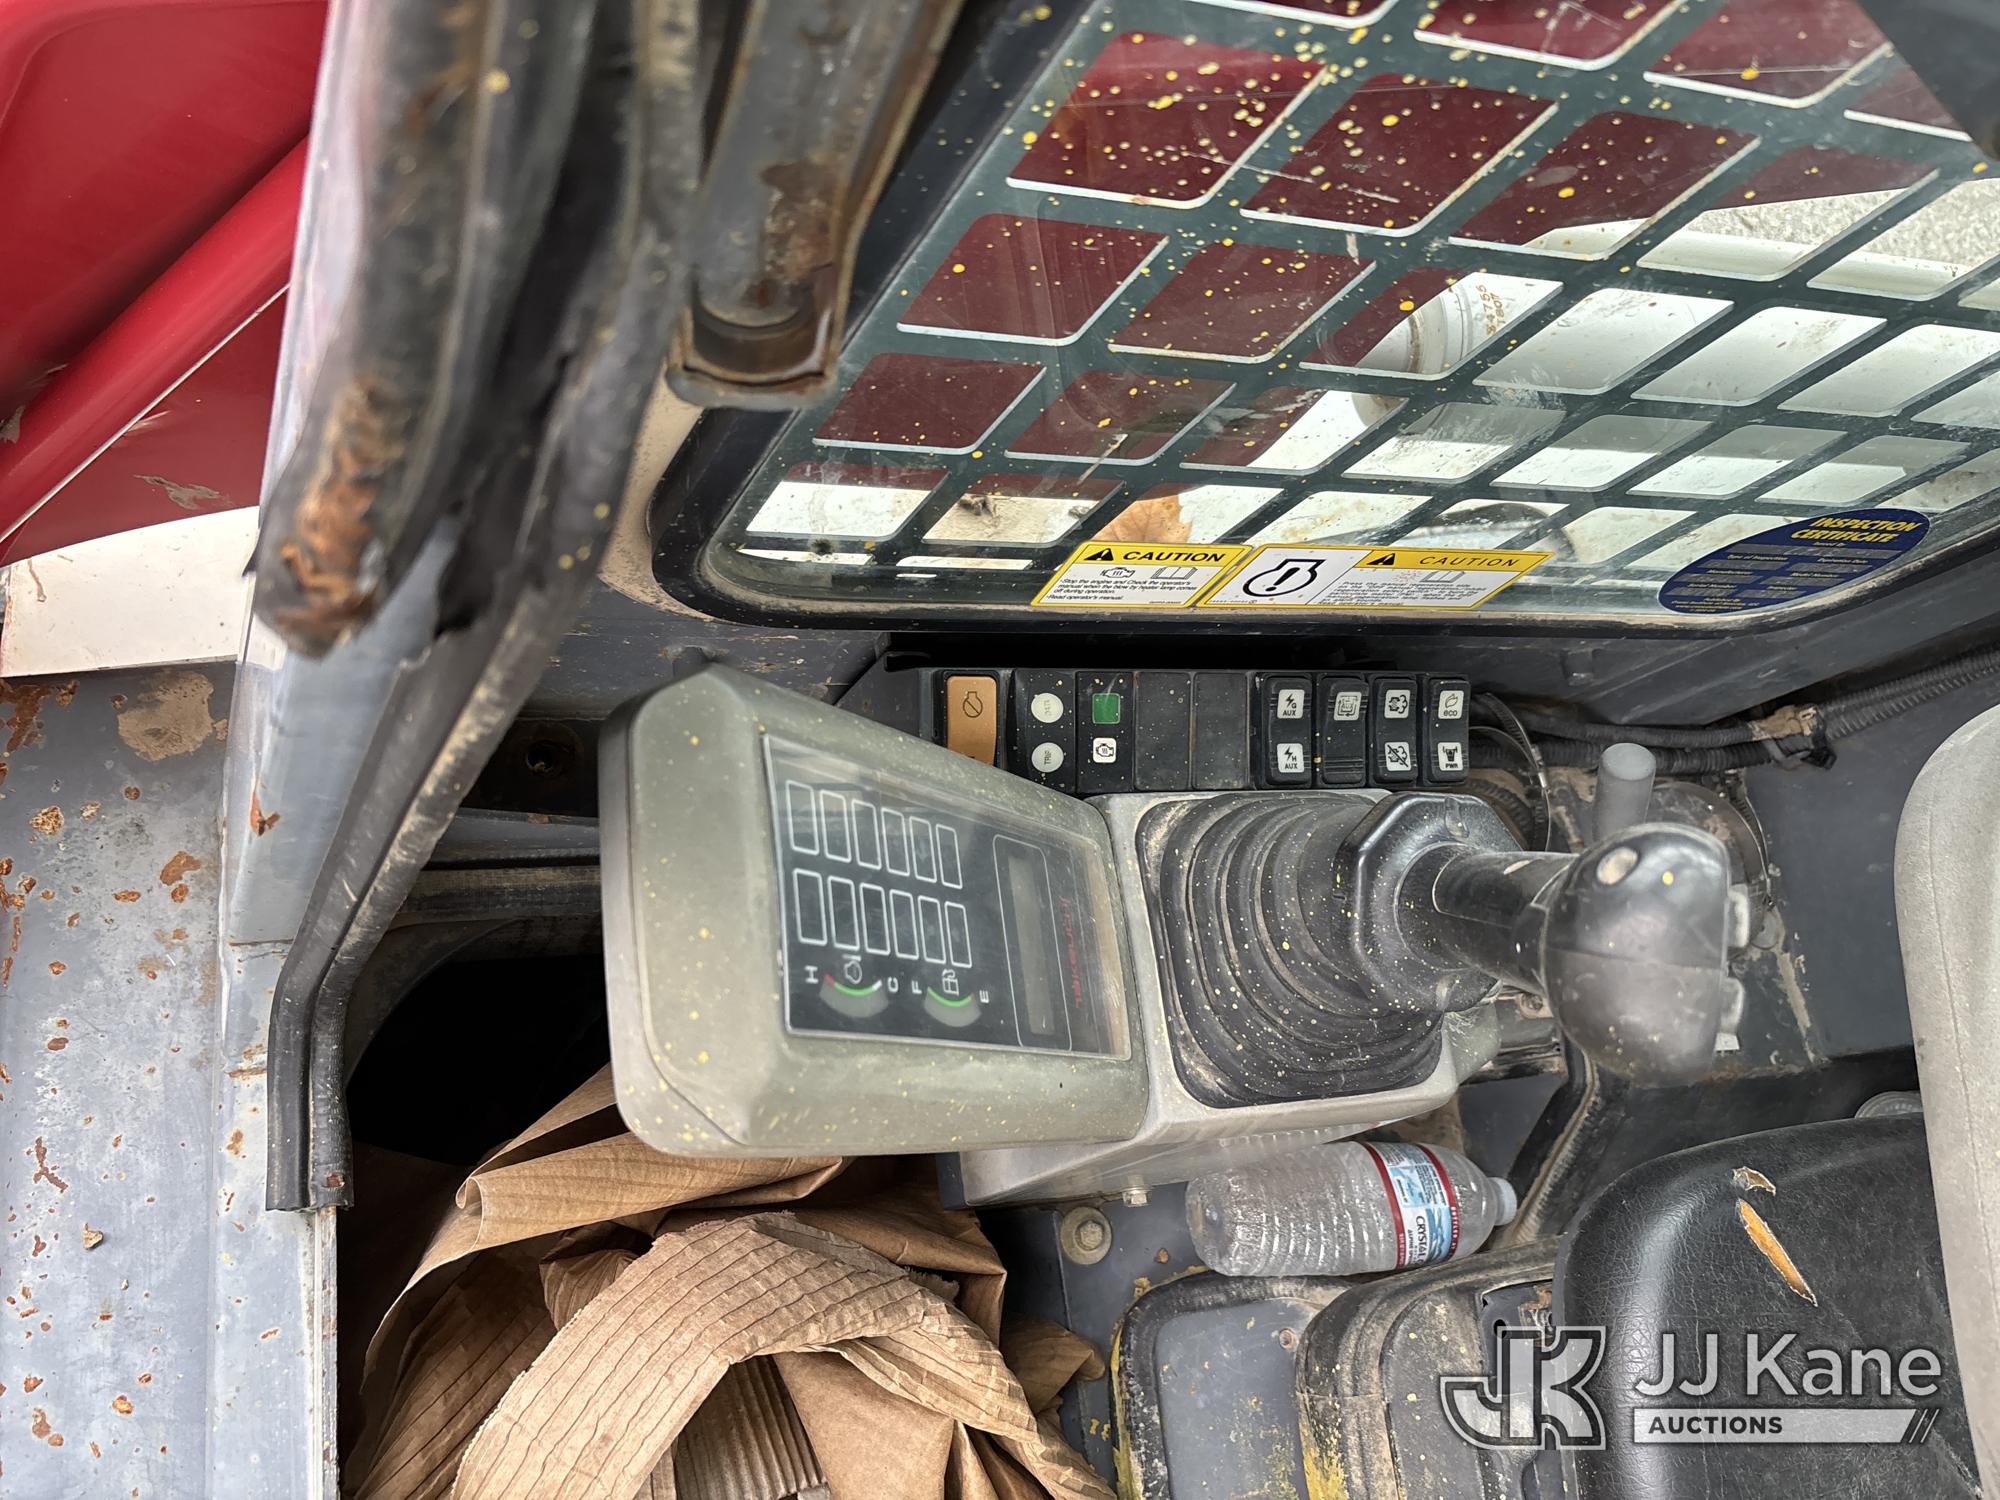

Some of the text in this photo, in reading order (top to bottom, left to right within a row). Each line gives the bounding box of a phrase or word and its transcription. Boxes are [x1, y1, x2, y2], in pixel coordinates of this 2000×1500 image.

[1810, 517, 1922, 532] INSPECTION
[1791, 529, 1899, 543] CERTIFICATE
[1123, 551, 1226, 562] CAUTION
[1419, 556, 1520, 567] CAUTION
[804, 965, 819, 984] H
[888, 977, 899, 993] C
[911, 980, 923, 994] F
[979, 989, 989, 1004] E
[1415, 1215, 1427, 1256] CRYSTAL
